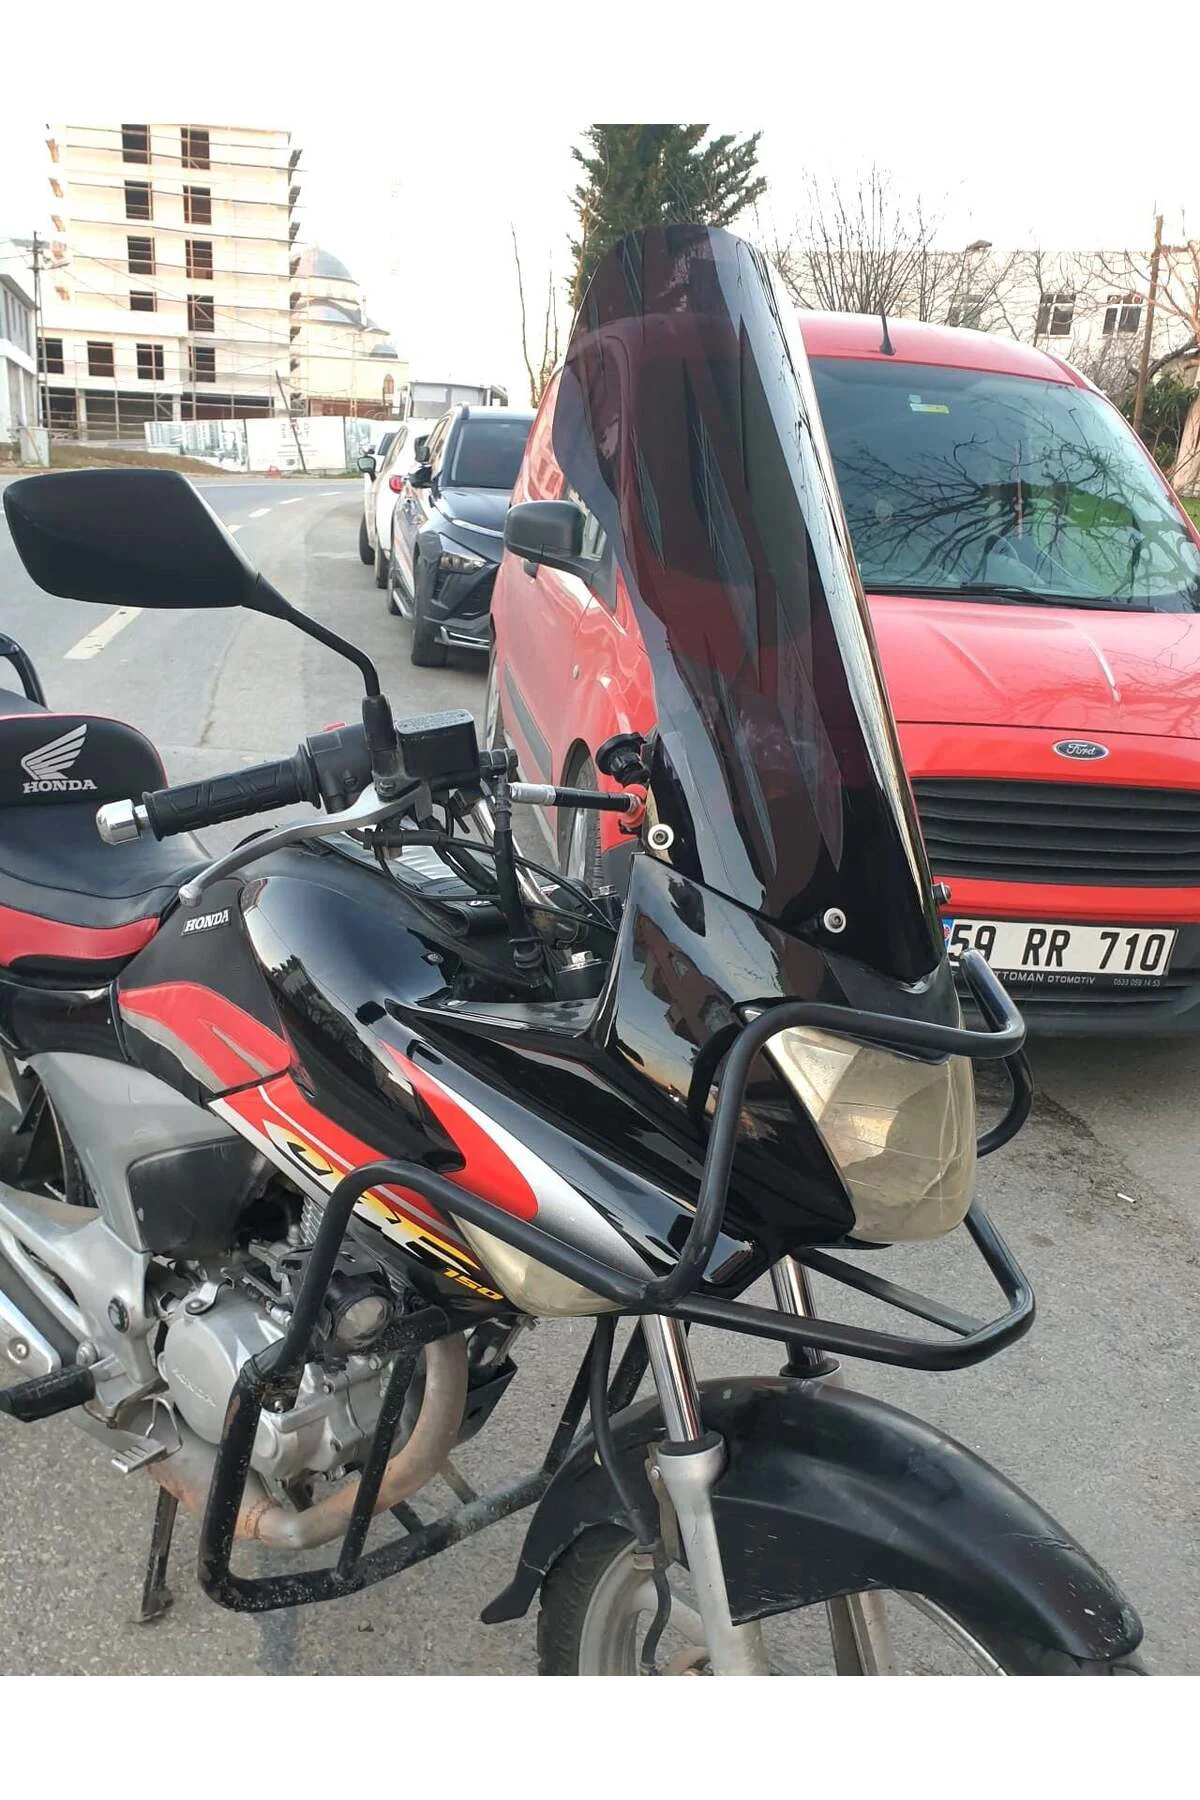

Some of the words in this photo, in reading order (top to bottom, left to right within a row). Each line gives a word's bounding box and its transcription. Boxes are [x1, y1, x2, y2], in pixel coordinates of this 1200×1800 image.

[1066, 743, 1096, 756] Ford
[23, 779, 98, 794] HONDA
[183, 909, 230, 933] HONDA
[948, 924, 997, 963] 59
[1021, 928, 1072, 968] RR
[1099, 931, 1166, 972] 710
[443, 1267, 504, 1300] 150
